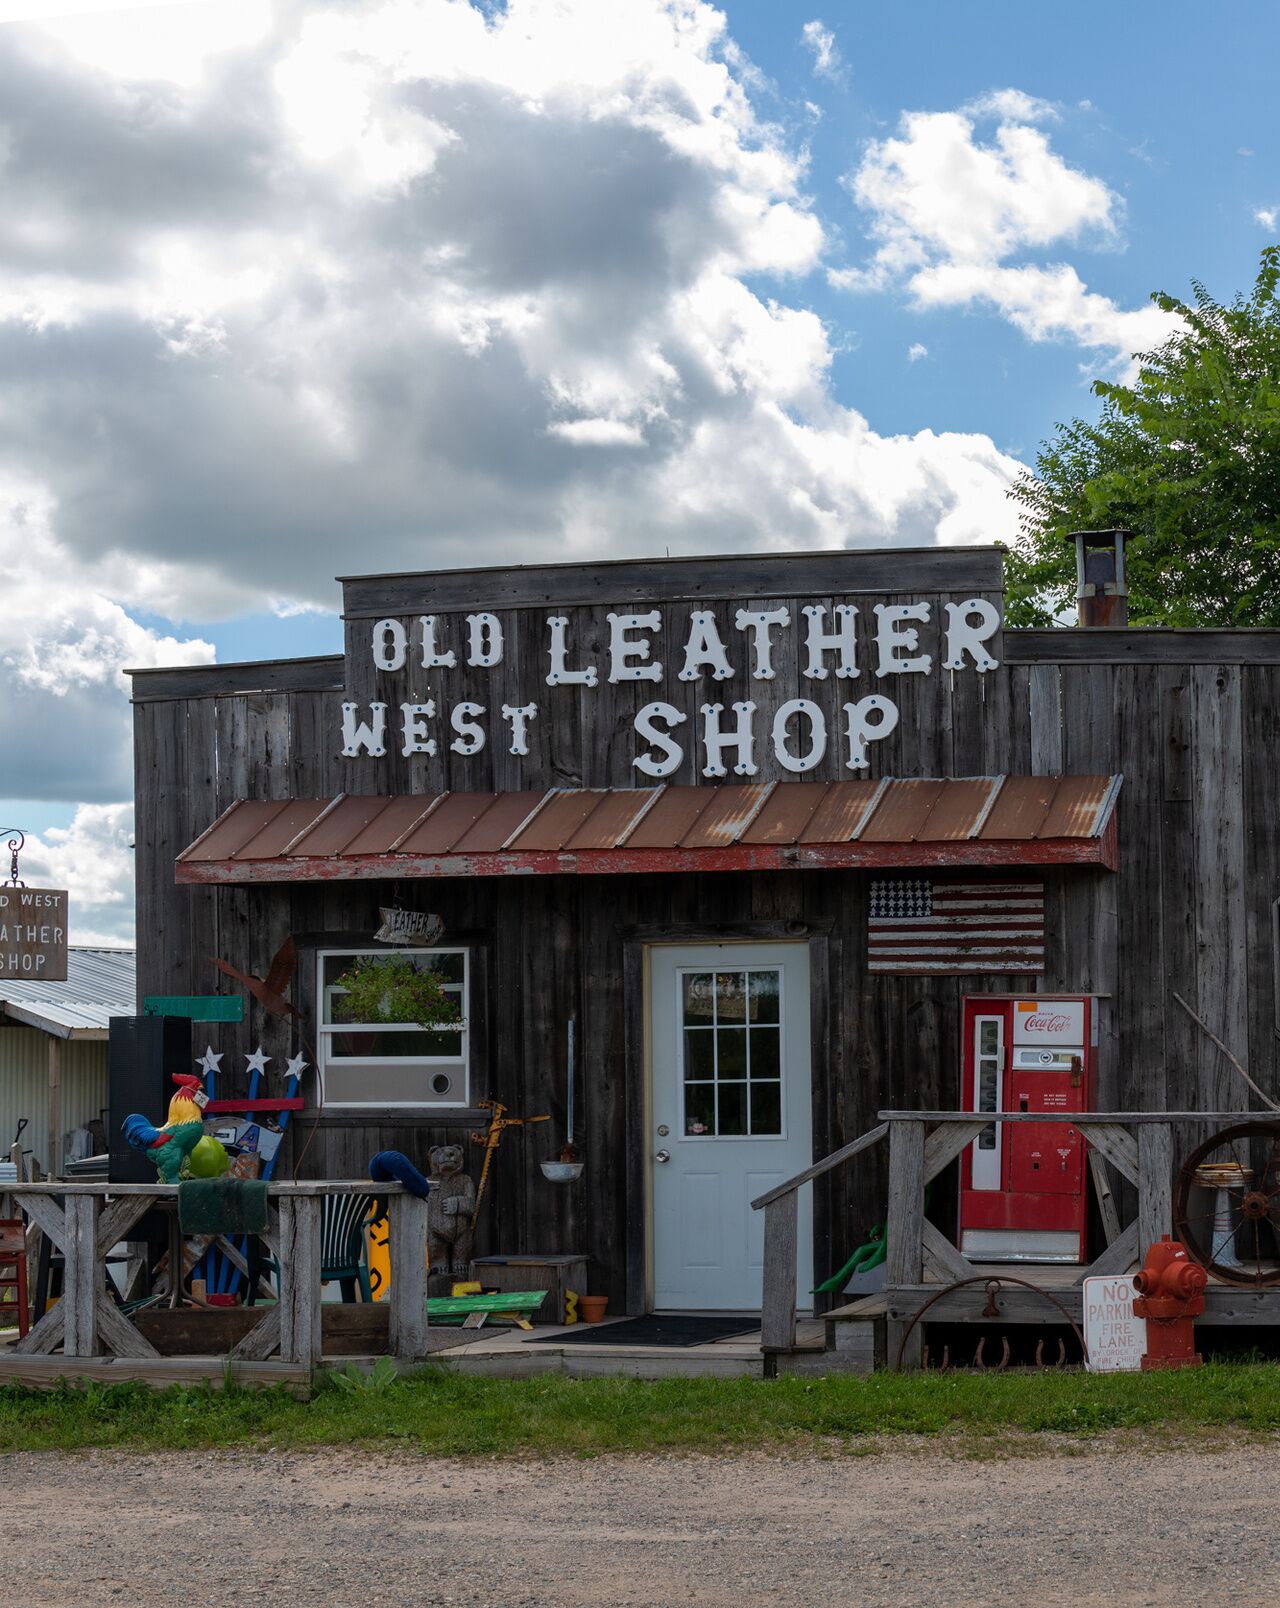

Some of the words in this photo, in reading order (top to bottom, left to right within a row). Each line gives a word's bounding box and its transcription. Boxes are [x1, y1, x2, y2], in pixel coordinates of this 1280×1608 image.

[371, 612, 504, 672] OLD
[546, 598, 1000, 687] LEATHER
[341, 699, 538, 758] WEST
[632, 694, 899, 777] SHOP
[21, 894, 61, 907] WEST
[1103, 1284, 1129, 1302] NO
[1089, 1303, 1135, 1322] PARKIN
[1102, 1323, 1132, 1335] FIRE
[1099, 1335, 1136, 1348] LANE
[1092, 1350, 1101, 1358] BY
[1107, 1348, 1129, 1357] ORDER
[1097, 1357, 1113, 1365] FIRE
